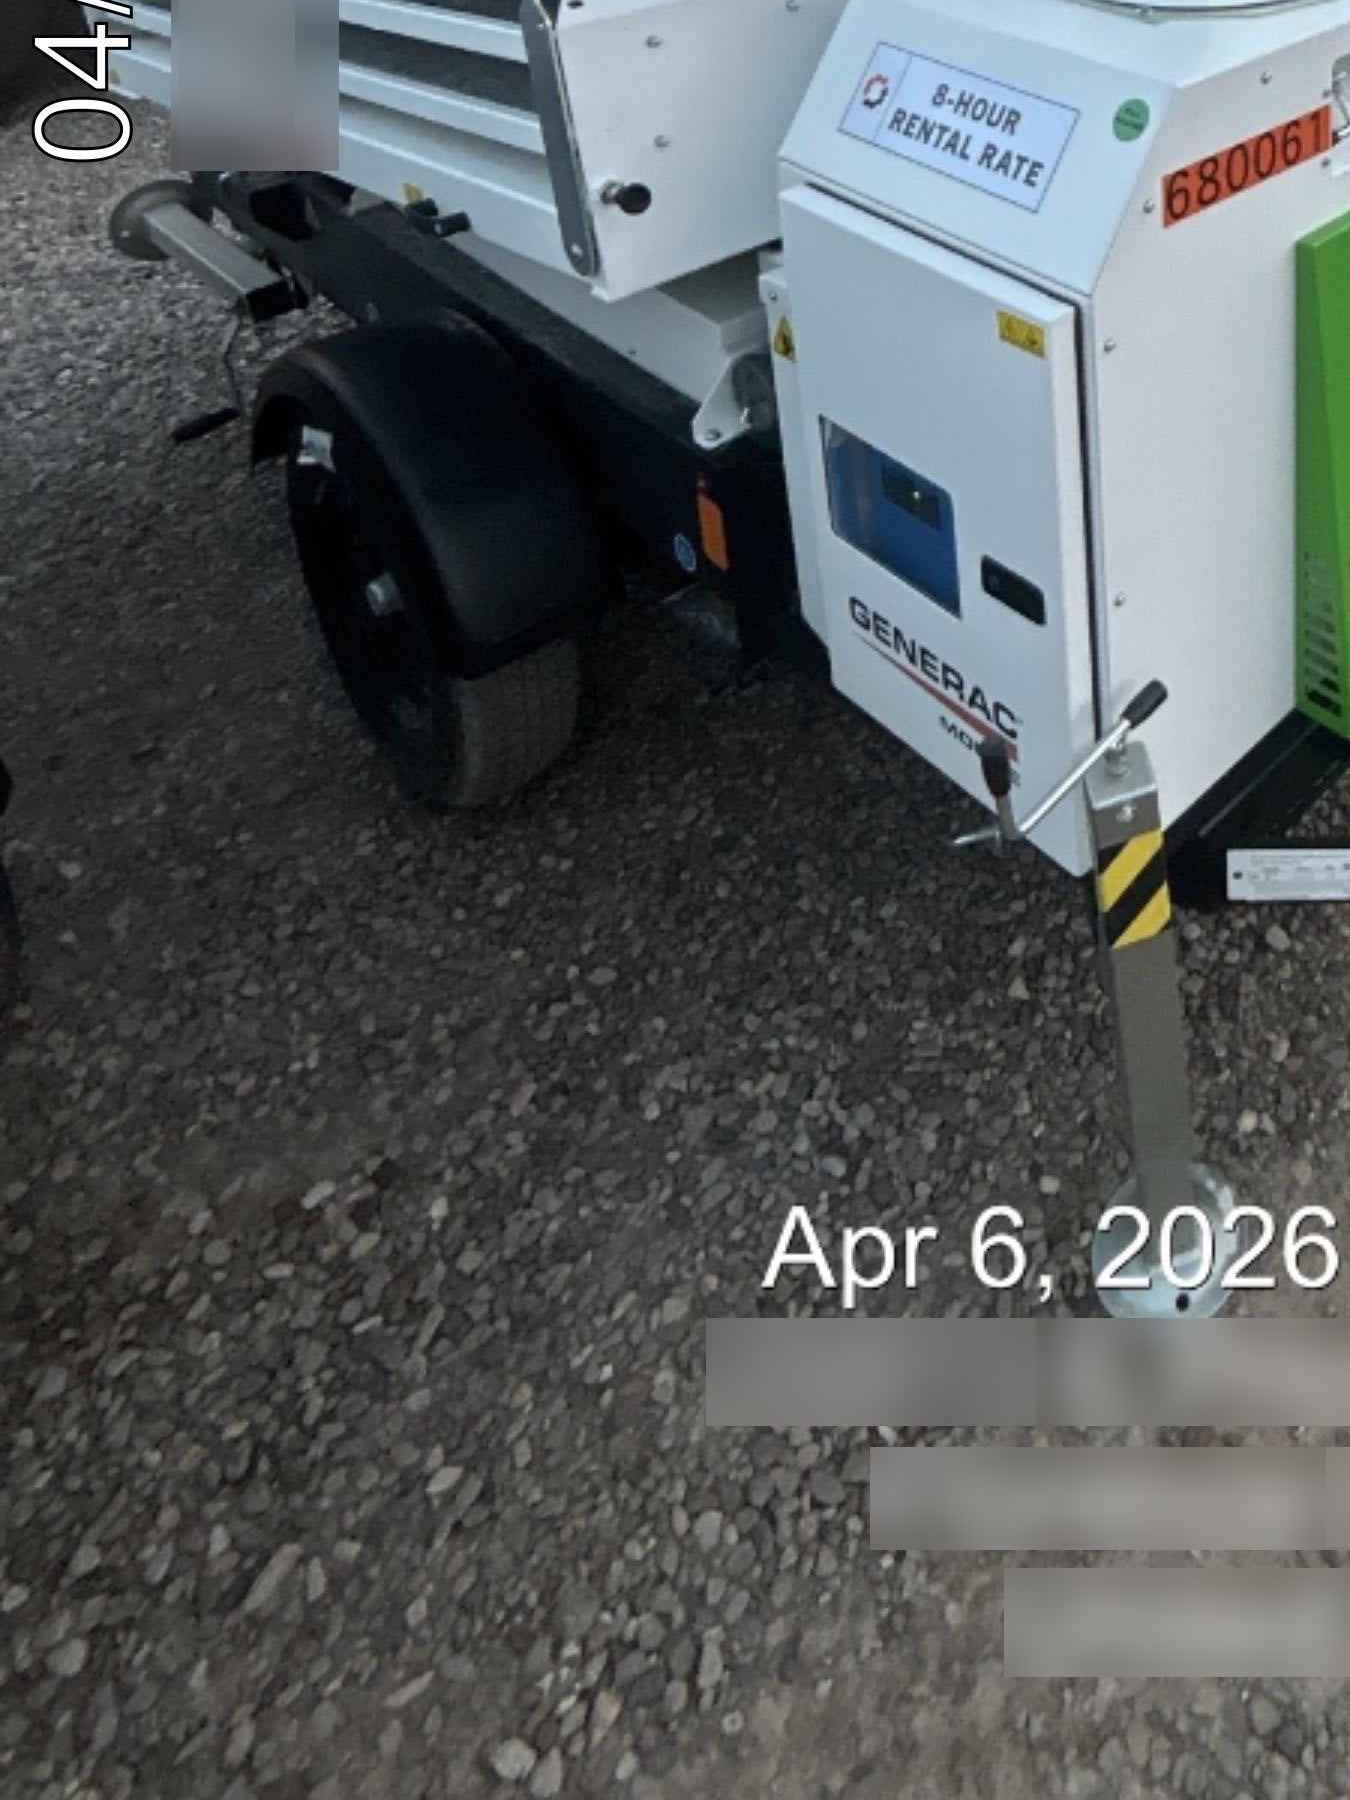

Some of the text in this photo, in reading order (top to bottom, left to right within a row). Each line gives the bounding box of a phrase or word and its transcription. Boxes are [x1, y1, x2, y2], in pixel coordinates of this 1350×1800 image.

[888, 107, 1044, 188] RENTAL RATE
[931, 83, 1021, 136] 8-HOUR
[1166, 111, 1321, 220] 680061
[849, 596, 1018, 739] GENERAC
